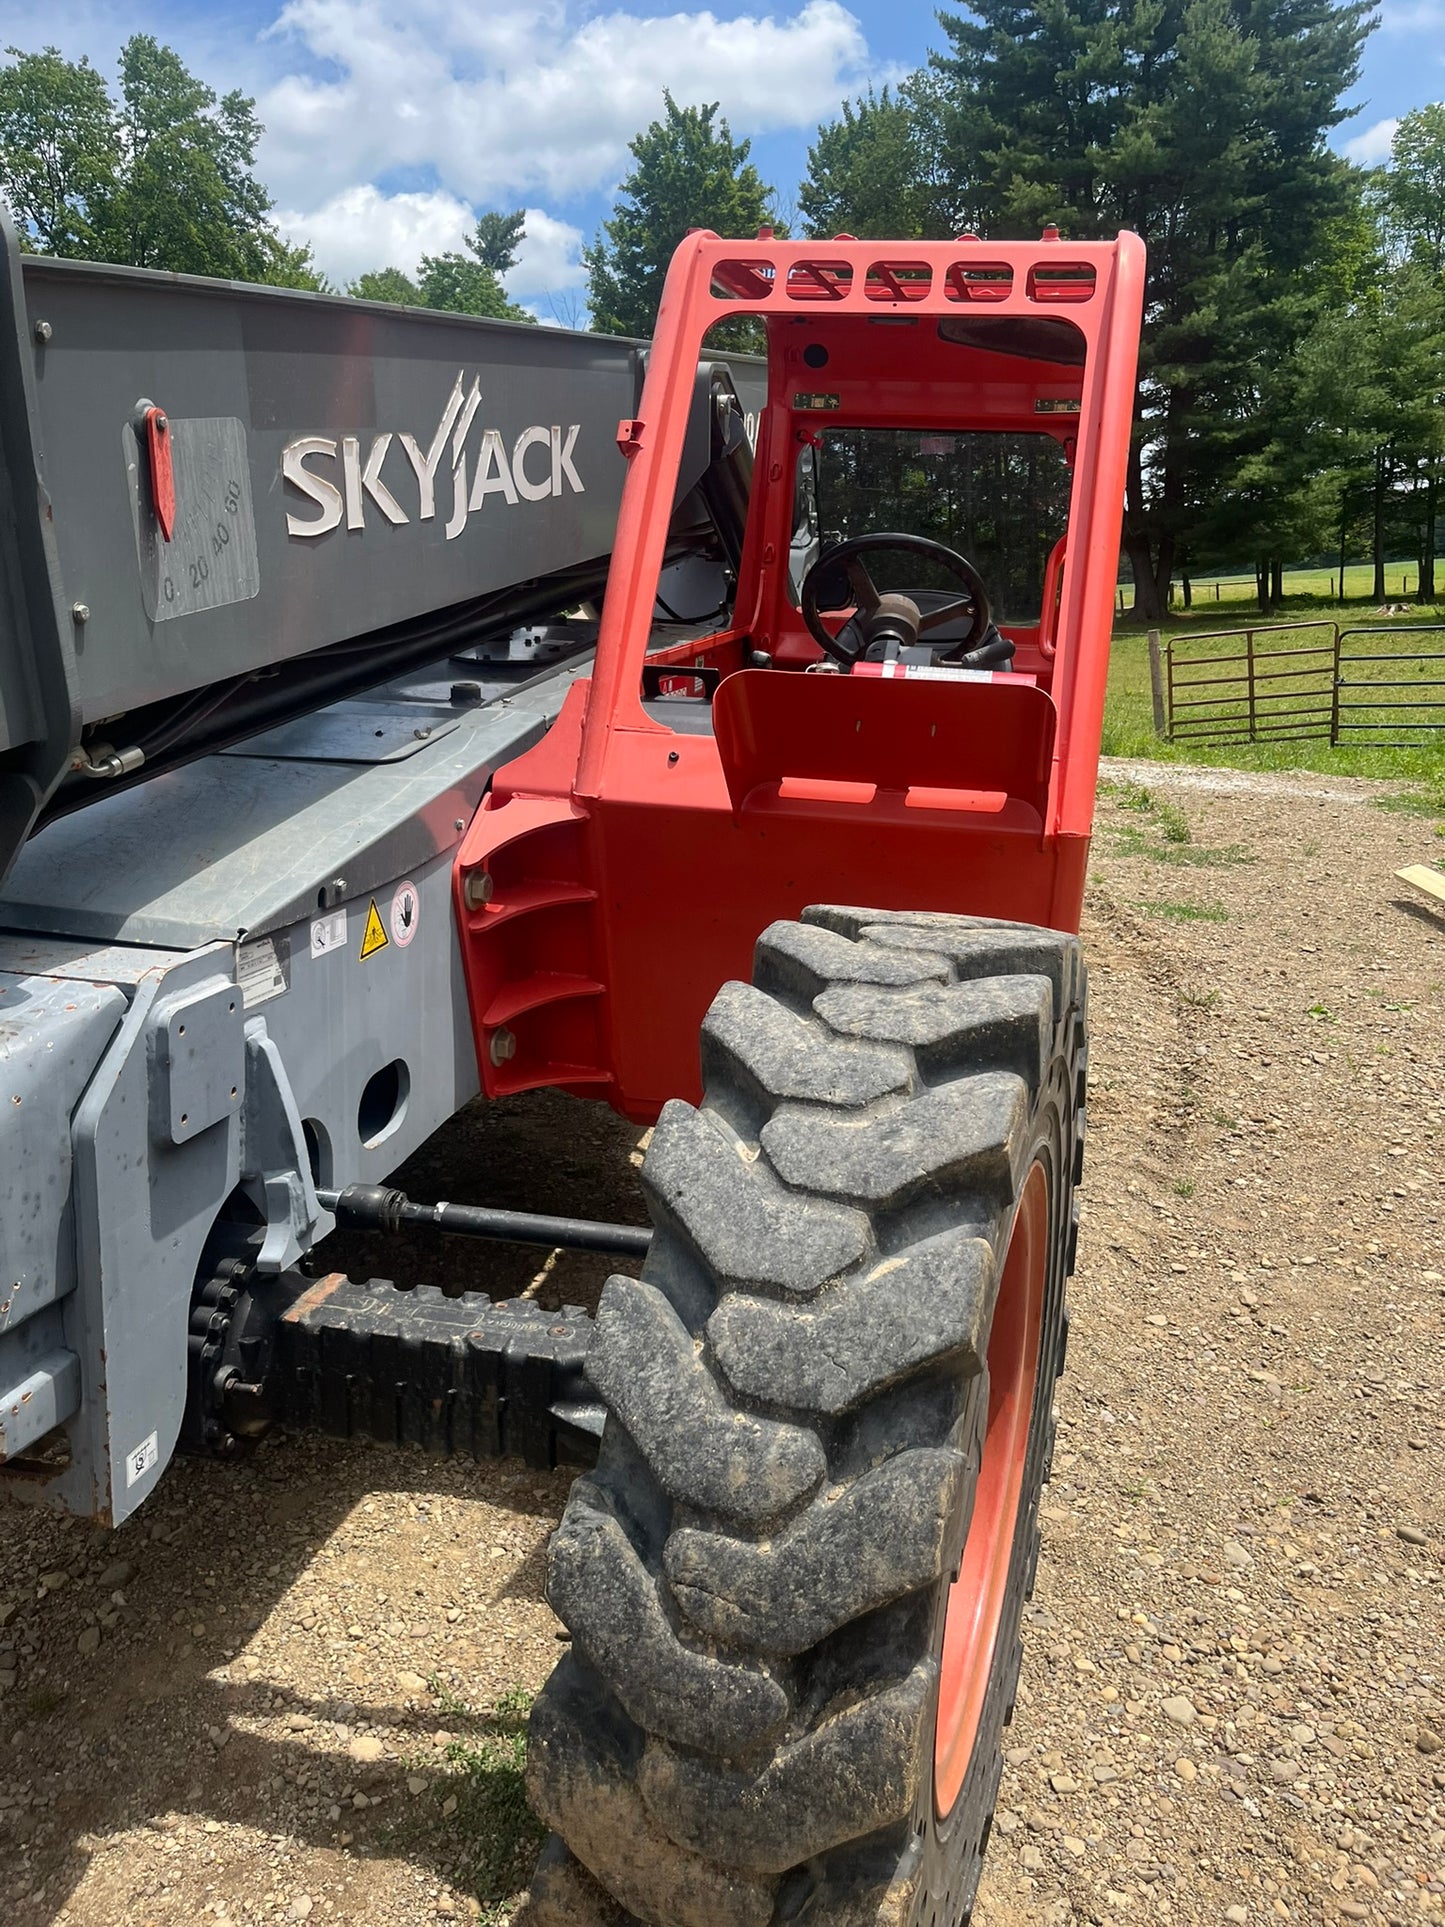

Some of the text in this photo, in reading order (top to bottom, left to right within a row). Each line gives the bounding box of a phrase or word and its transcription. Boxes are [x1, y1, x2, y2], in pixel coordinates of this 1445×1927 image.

[282, 368, 585, 541] SKYJACK
[164, 576, 175, 602] 0
[189, 555, 209, 588] 20
[211, 522, 231, 557] 40
